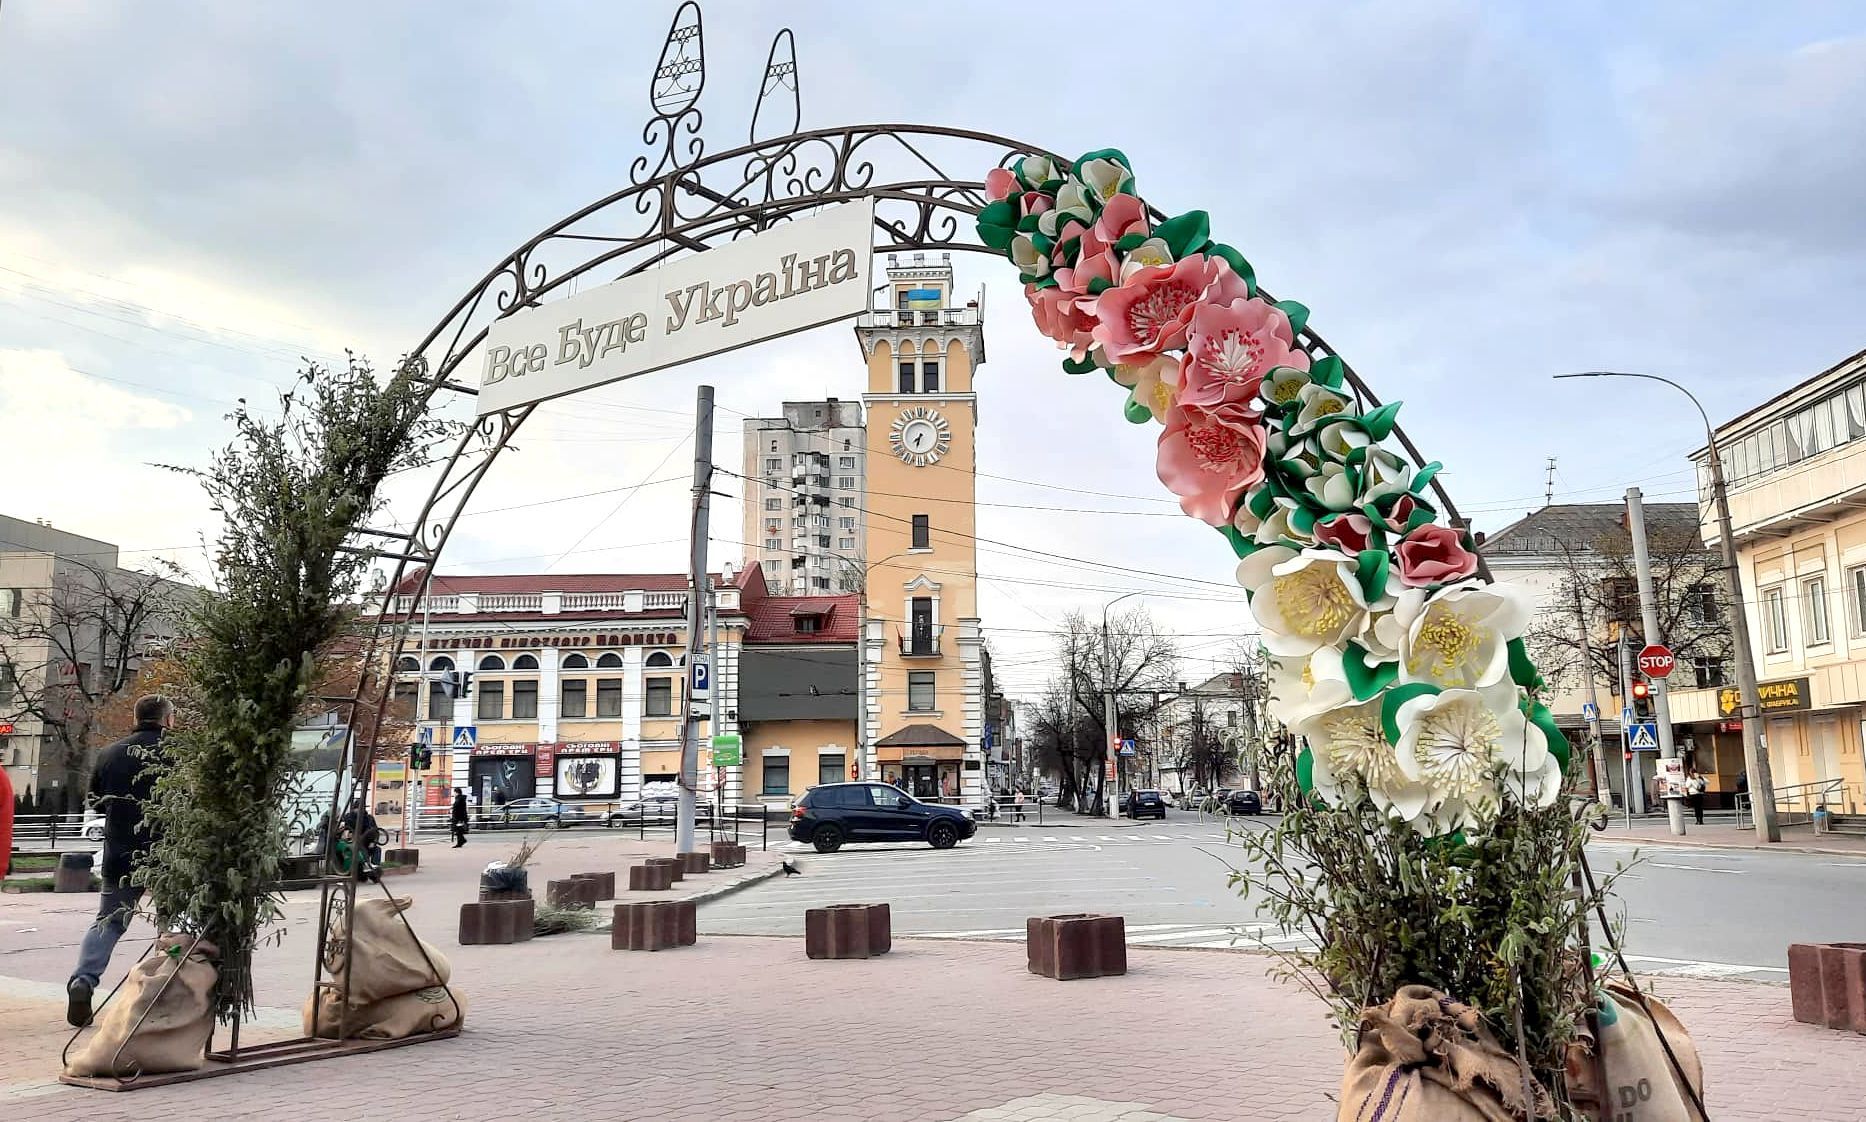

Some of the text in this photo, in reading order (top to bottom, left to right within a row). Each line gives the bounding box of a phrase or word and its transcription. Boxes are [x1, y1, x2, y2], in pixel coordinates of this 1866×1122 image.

[484, 248, 859, 386] Все Буде Україна
[1640, 656, 1673, 669] STOP
[695, 664, 706, 688] P
